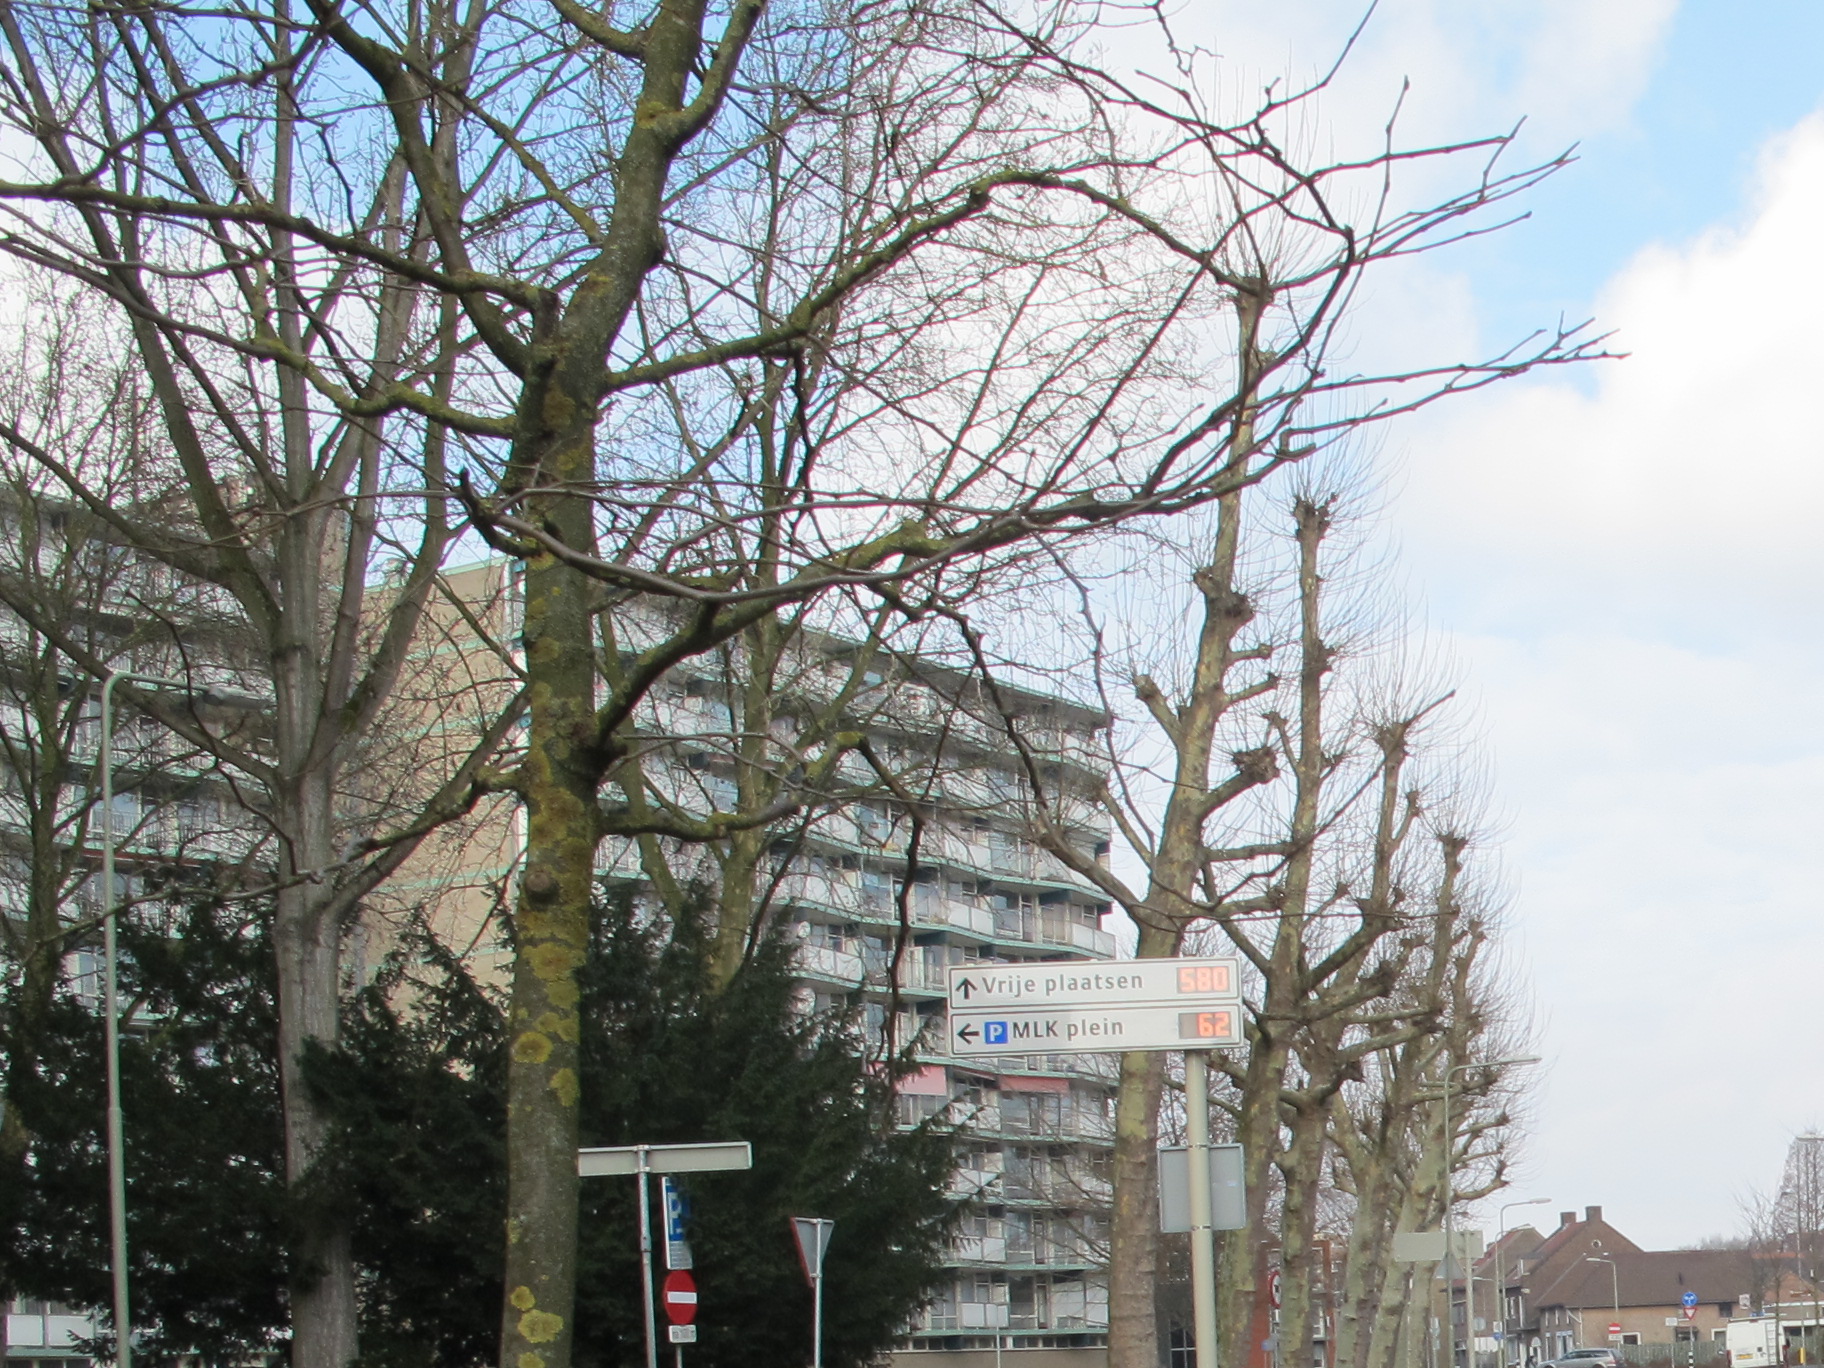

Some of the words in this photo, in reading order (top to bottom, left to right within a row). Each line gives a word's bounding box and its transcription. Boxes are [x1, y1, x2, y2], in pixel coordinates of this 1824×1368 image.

[981, 976, 1036, 998] Vrije
[1045, 973, 1143, 995] plaatsen
[1178, 967, 1229, 993] 580
[1012, 1021, 1057, 1039] MLK
[1066, 1018, 1123, 1041] plein
[1197, 1013, 1230, 1037] 62
